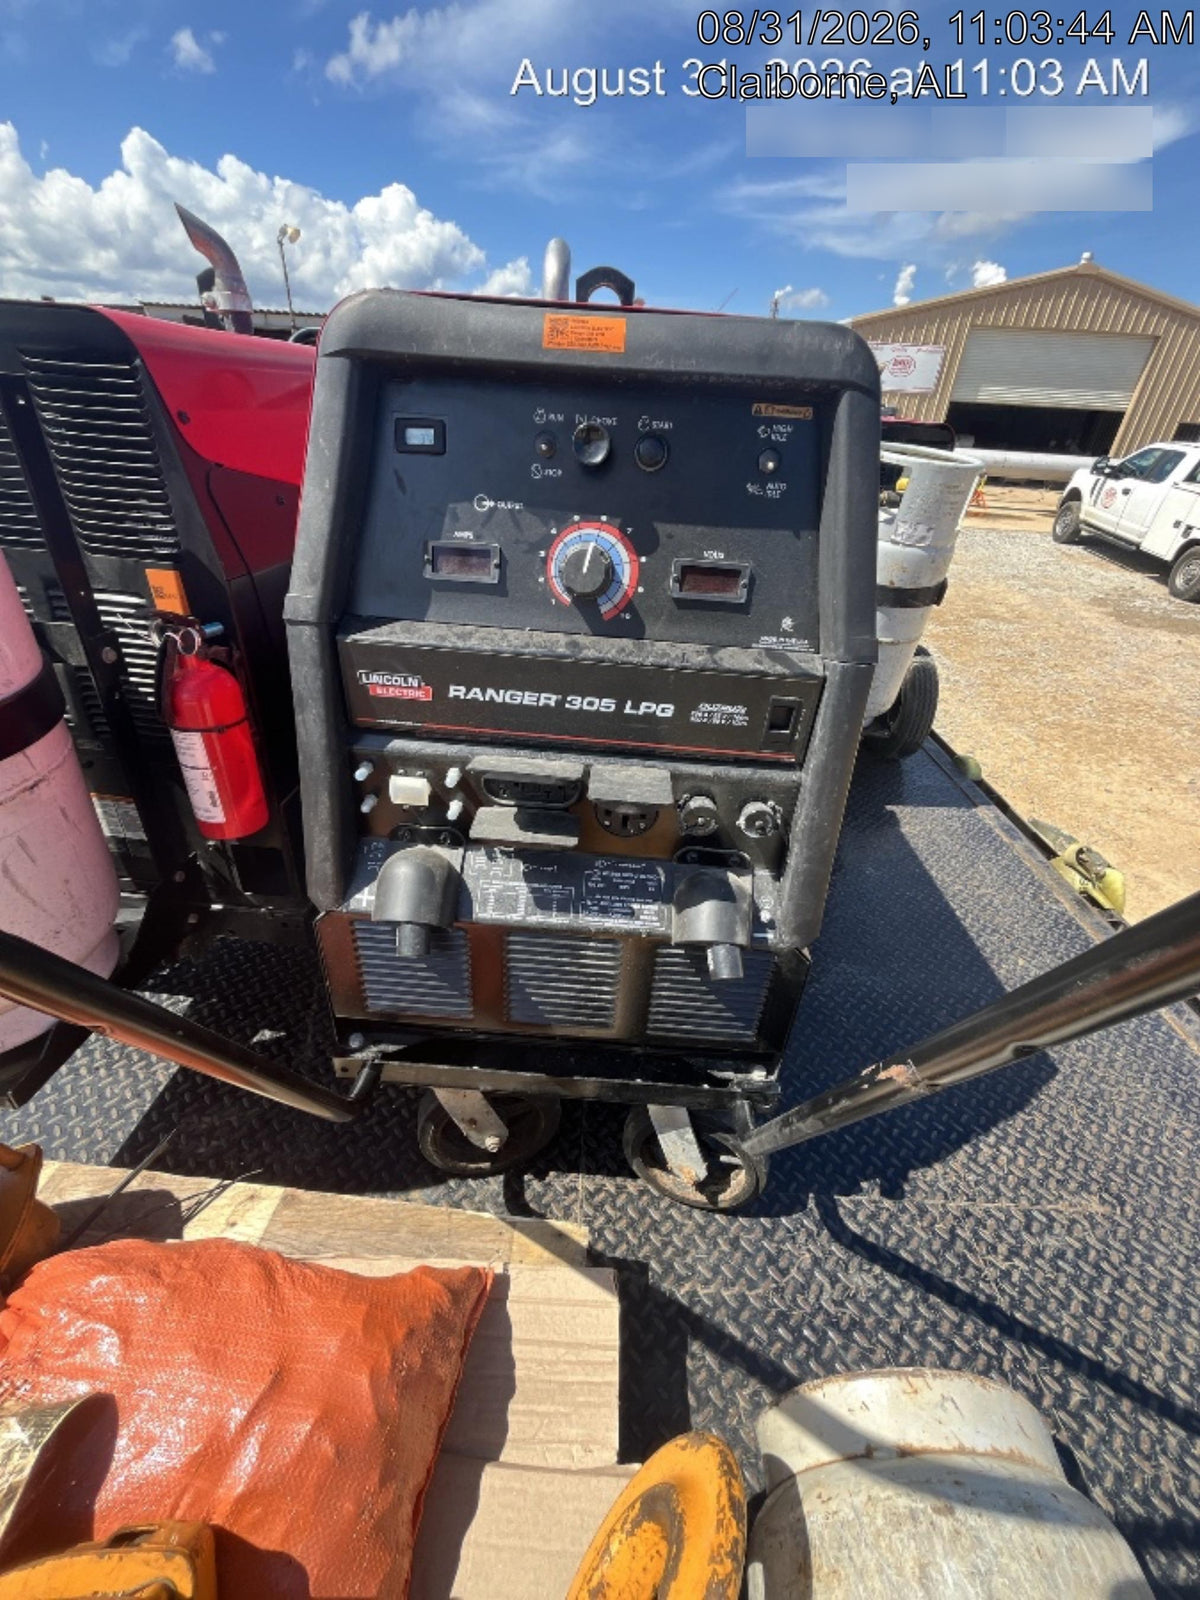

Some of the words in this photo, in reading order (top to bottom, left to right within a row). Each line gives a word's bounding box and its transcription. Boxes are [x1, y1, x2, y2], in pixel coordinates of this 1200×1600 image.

[362, 673, 419, 687] LINCOLN
[376, 687, 426, 698] ELECTRIC
[565, 696, 616, 712] 305
[624, 701, 674, 717] LPG
